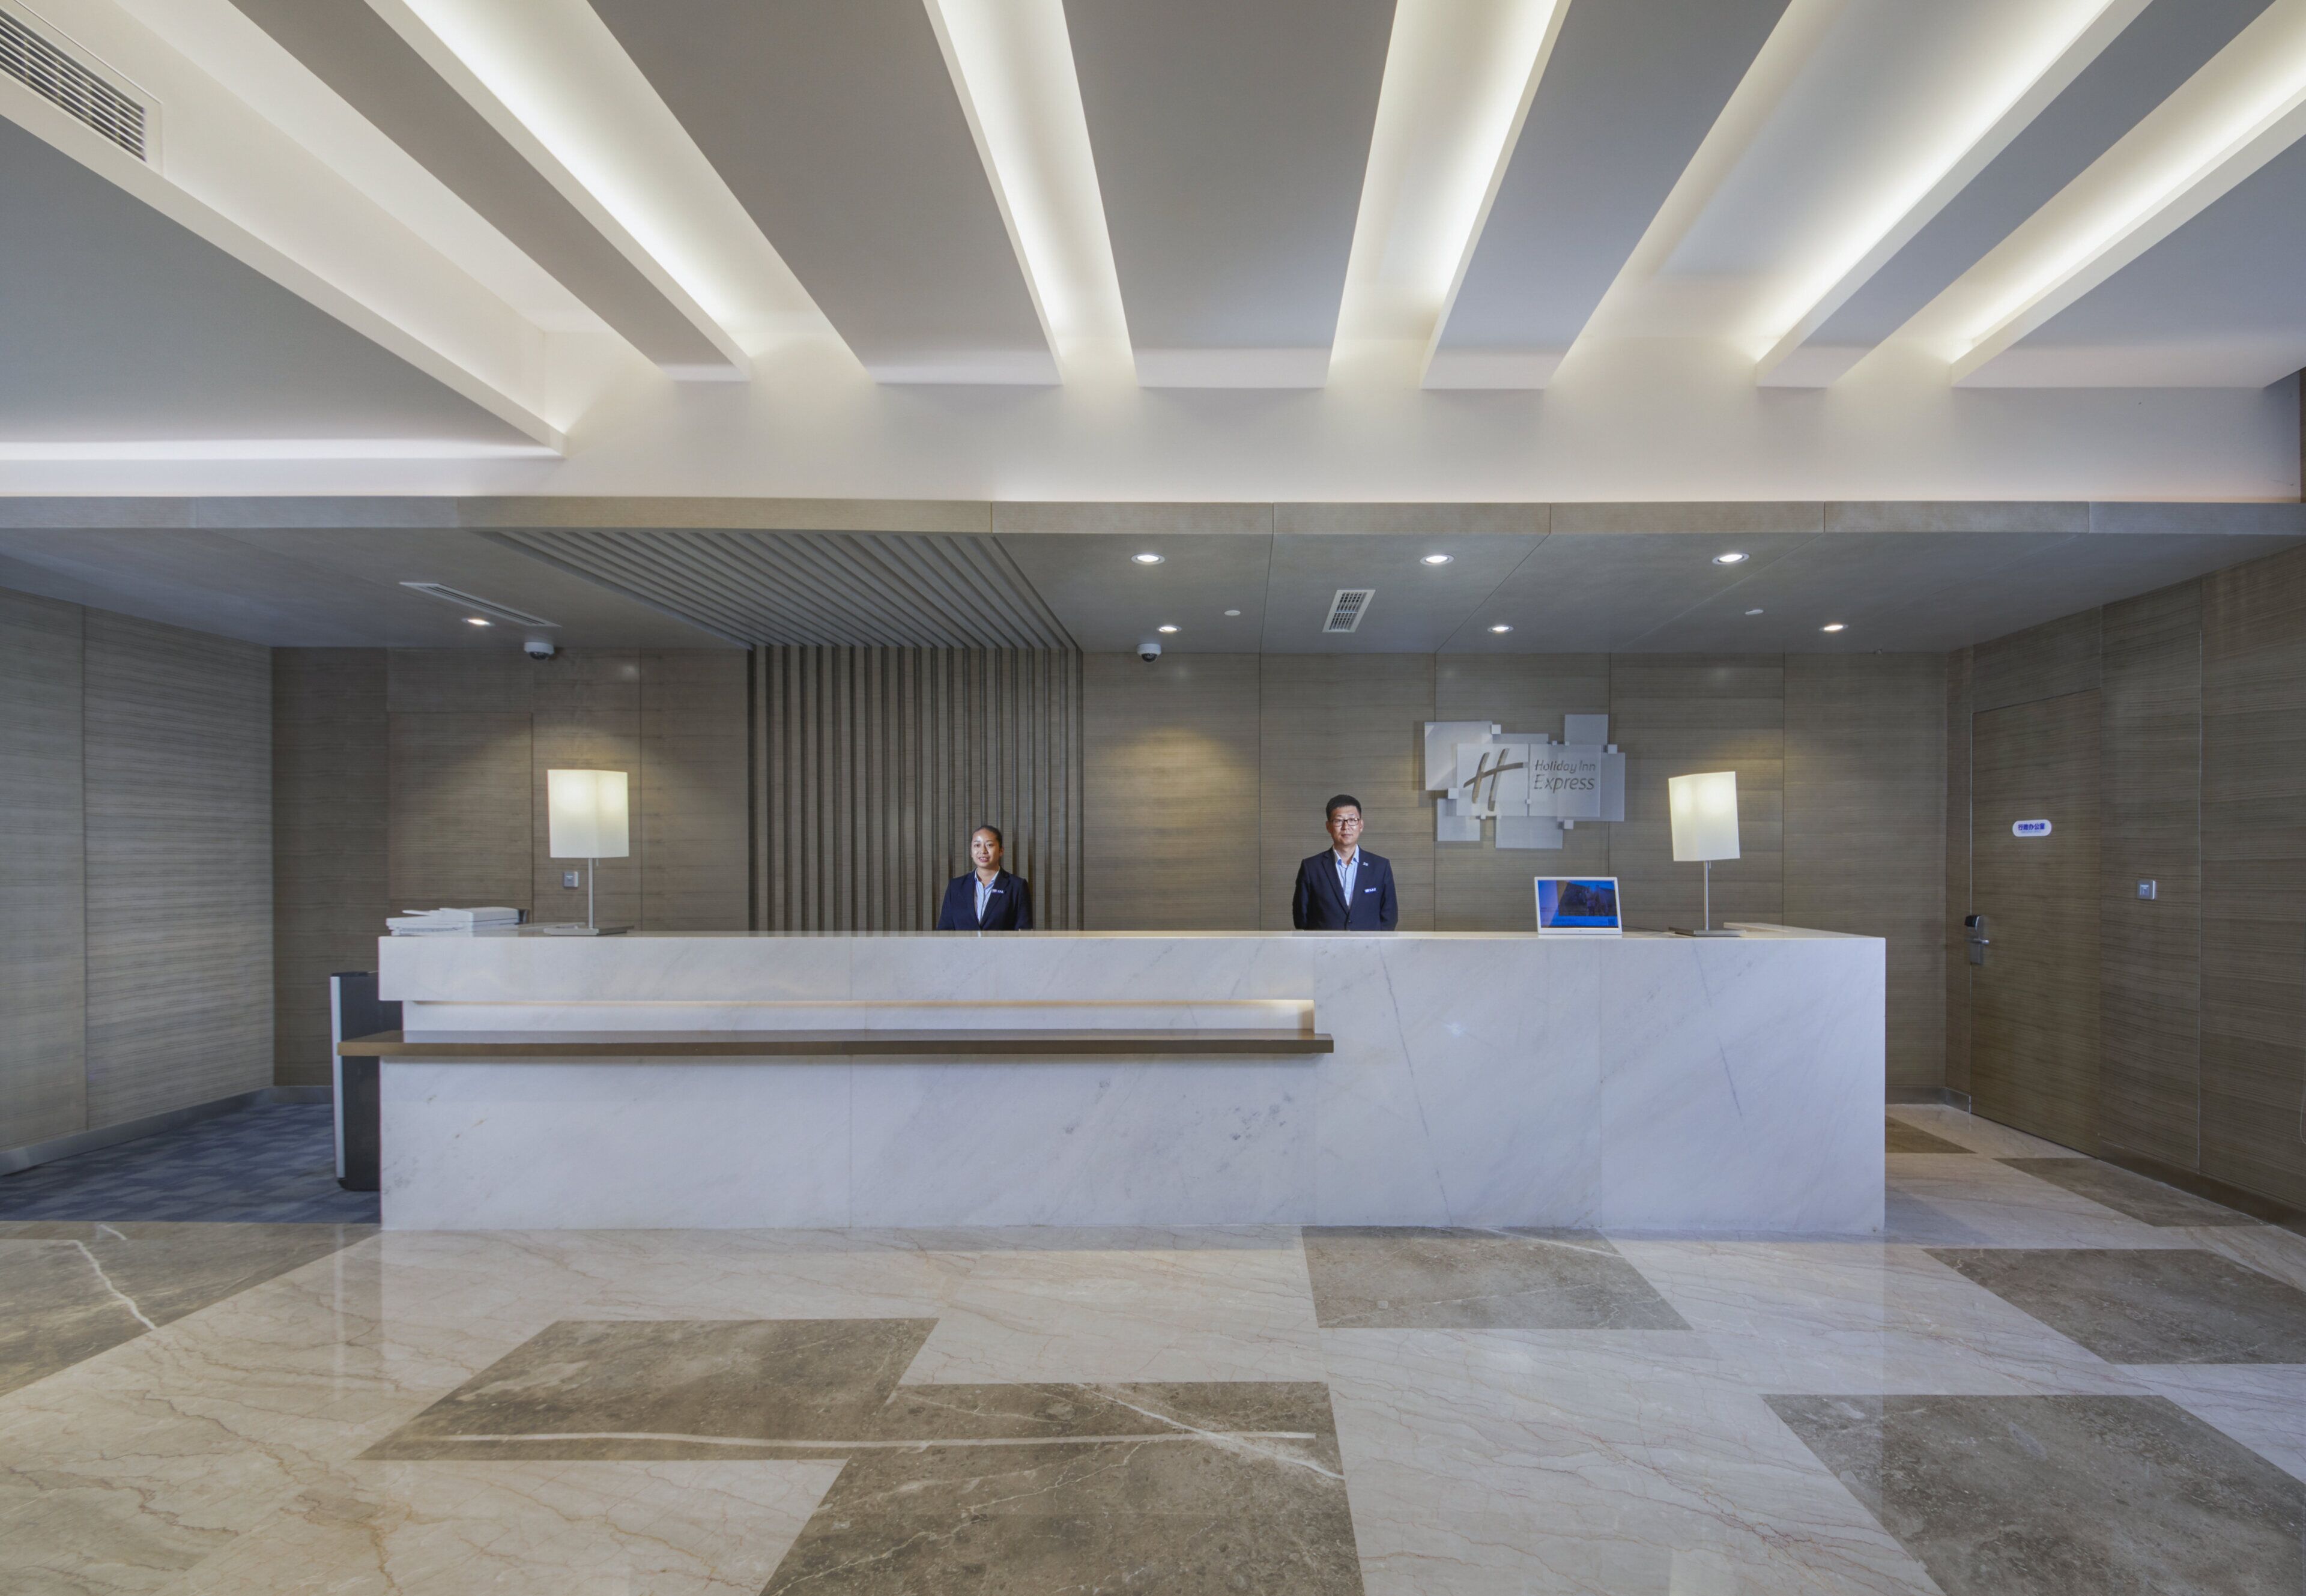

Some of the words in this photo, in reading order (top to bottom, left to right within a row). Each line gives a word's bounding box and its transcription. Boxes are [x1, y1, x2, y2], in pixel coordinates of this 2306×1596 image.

[1534, 760, 1577, 774] Holiday
[1578, 760, 1596, 772] Inn
[1534, 774, 1595, 794] Express
